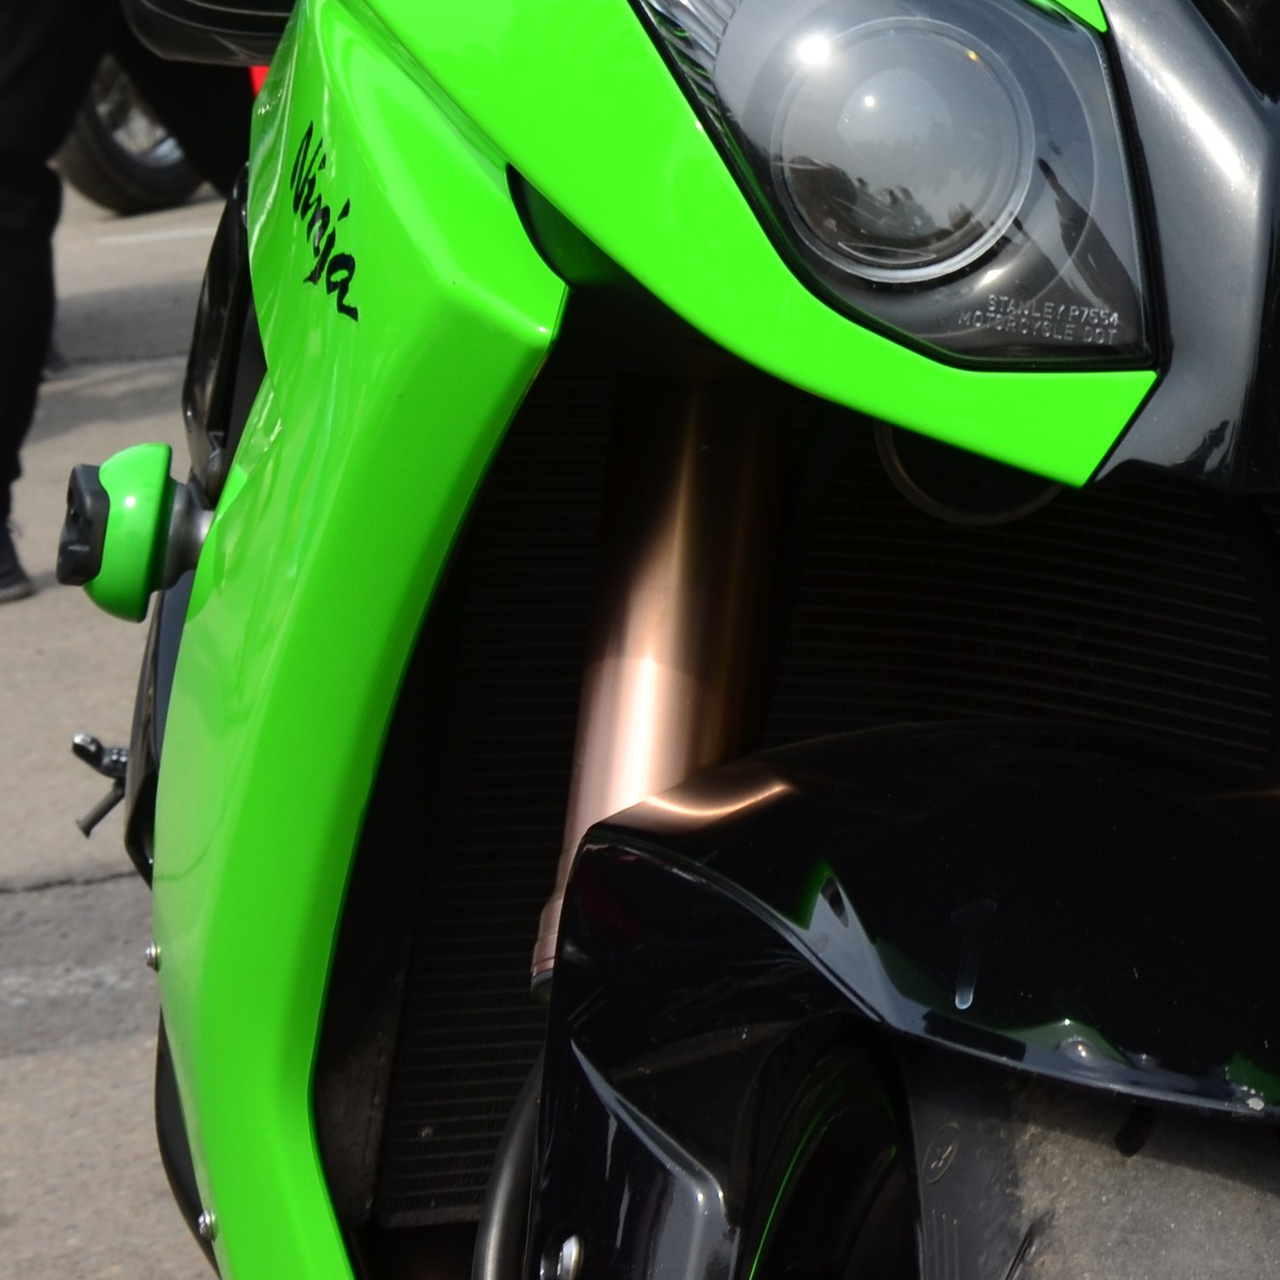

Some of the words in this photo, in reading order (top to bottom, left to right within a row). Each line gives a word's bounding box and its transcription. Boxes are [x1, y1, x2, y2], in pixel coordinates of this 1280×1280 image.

[290, 120, 359, 322] Ninja
[987, 293, 1066, 319] STANLEY
[957, 309, 1076, 341] MOTORCYCLE
[1083, 326, 1118, 345] DOT
